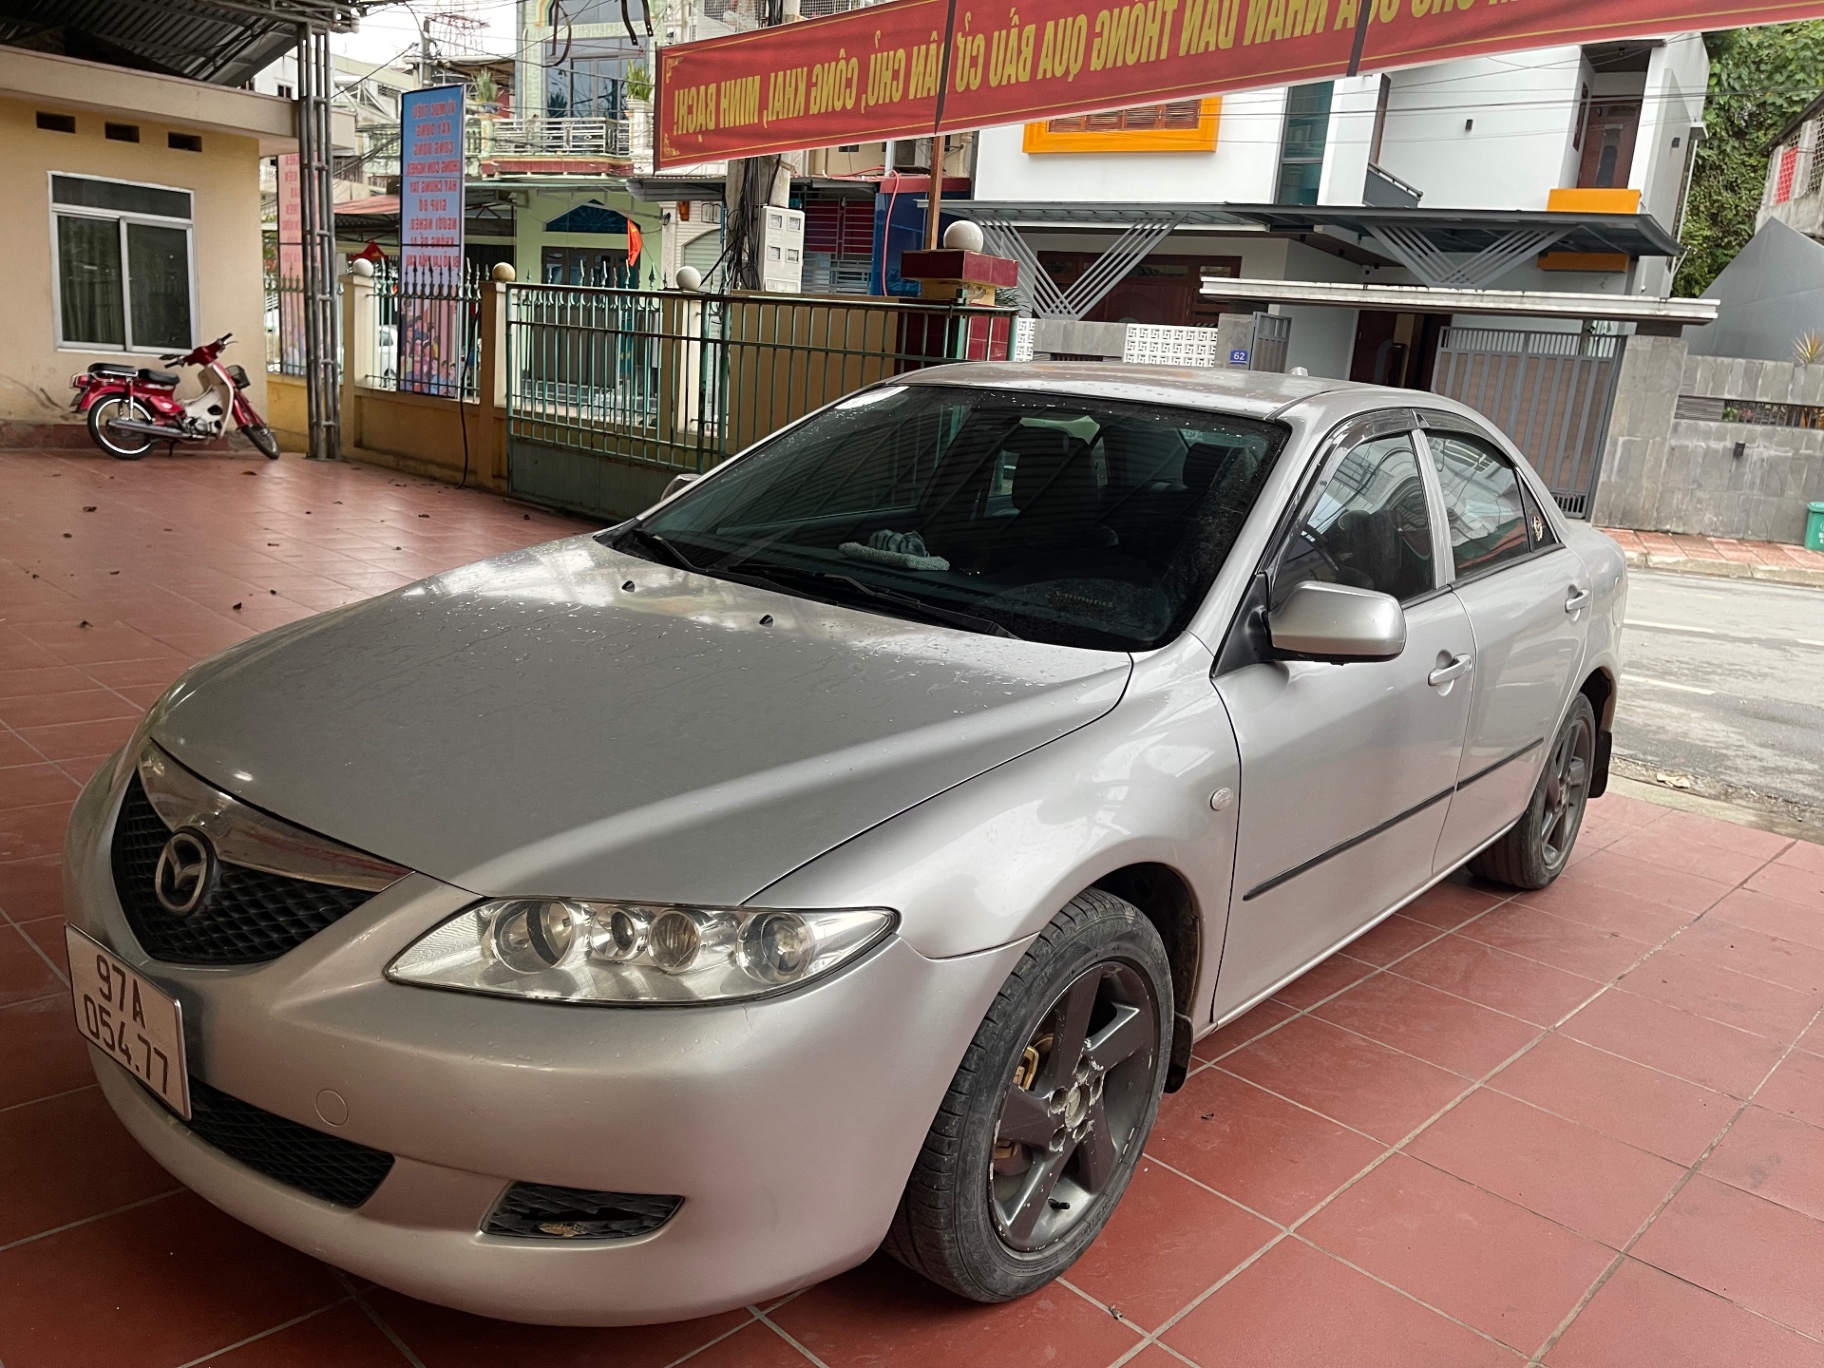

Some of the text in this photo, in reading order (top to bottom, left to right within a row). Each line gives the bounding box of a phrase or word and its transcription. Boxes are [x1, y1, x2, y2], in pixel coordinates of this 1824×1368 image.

[1233, 352, 1245, 360] 62
[97, 955, 145, 1029] 97A
[84, 994, 167, 1095] 054.77
